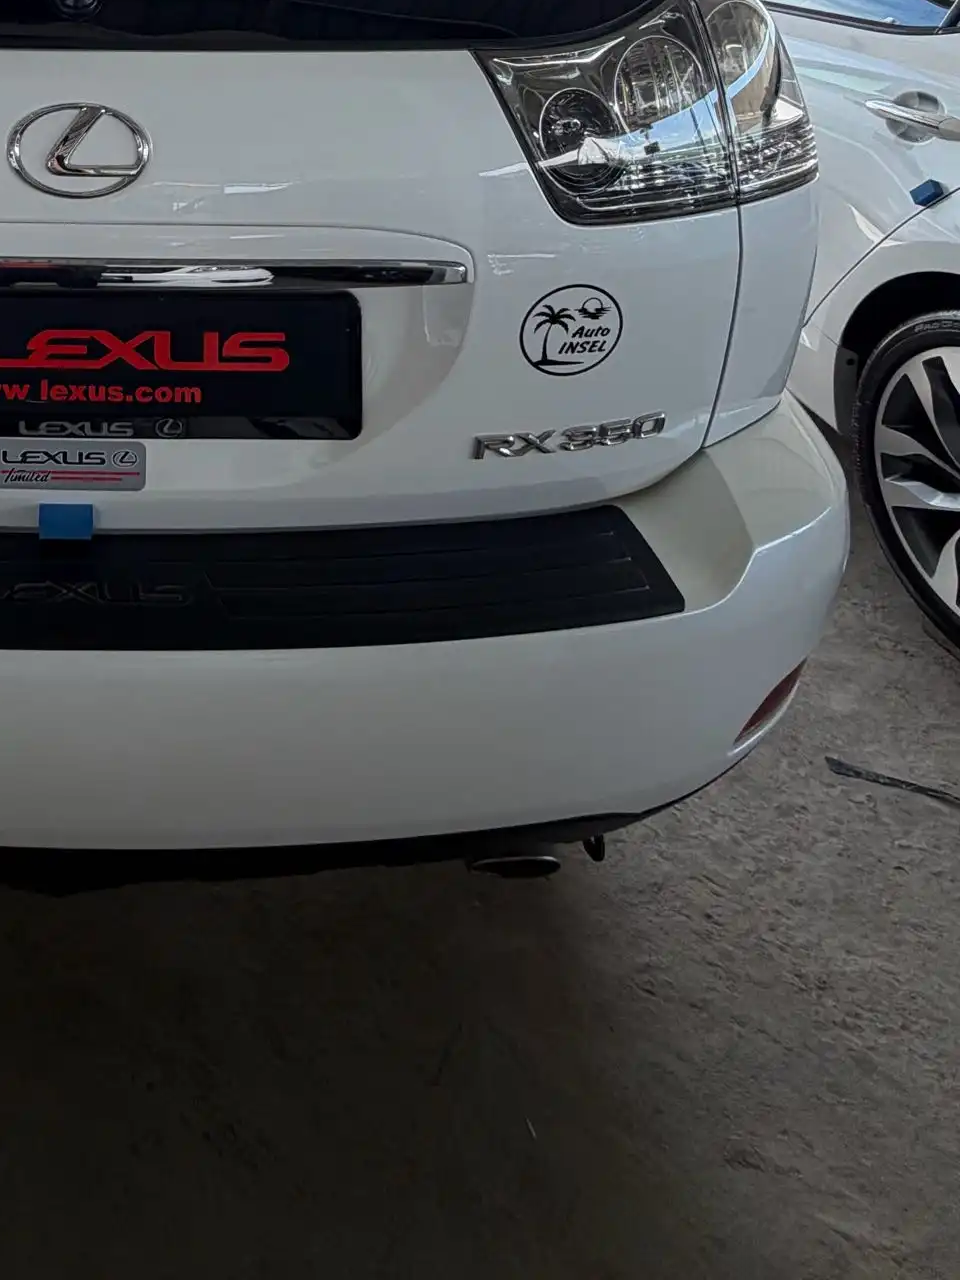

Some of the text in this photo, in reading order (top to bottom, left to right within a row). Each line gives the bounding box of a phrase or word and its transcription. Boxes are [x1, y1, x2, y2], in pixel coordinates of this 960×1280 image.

[572, 325, 611, 338] Auto
[558, 340, 607, 355] INSEL
[18, 420, 134, 437] LEXUS
[1, 450, 107, 466] LEXUS
